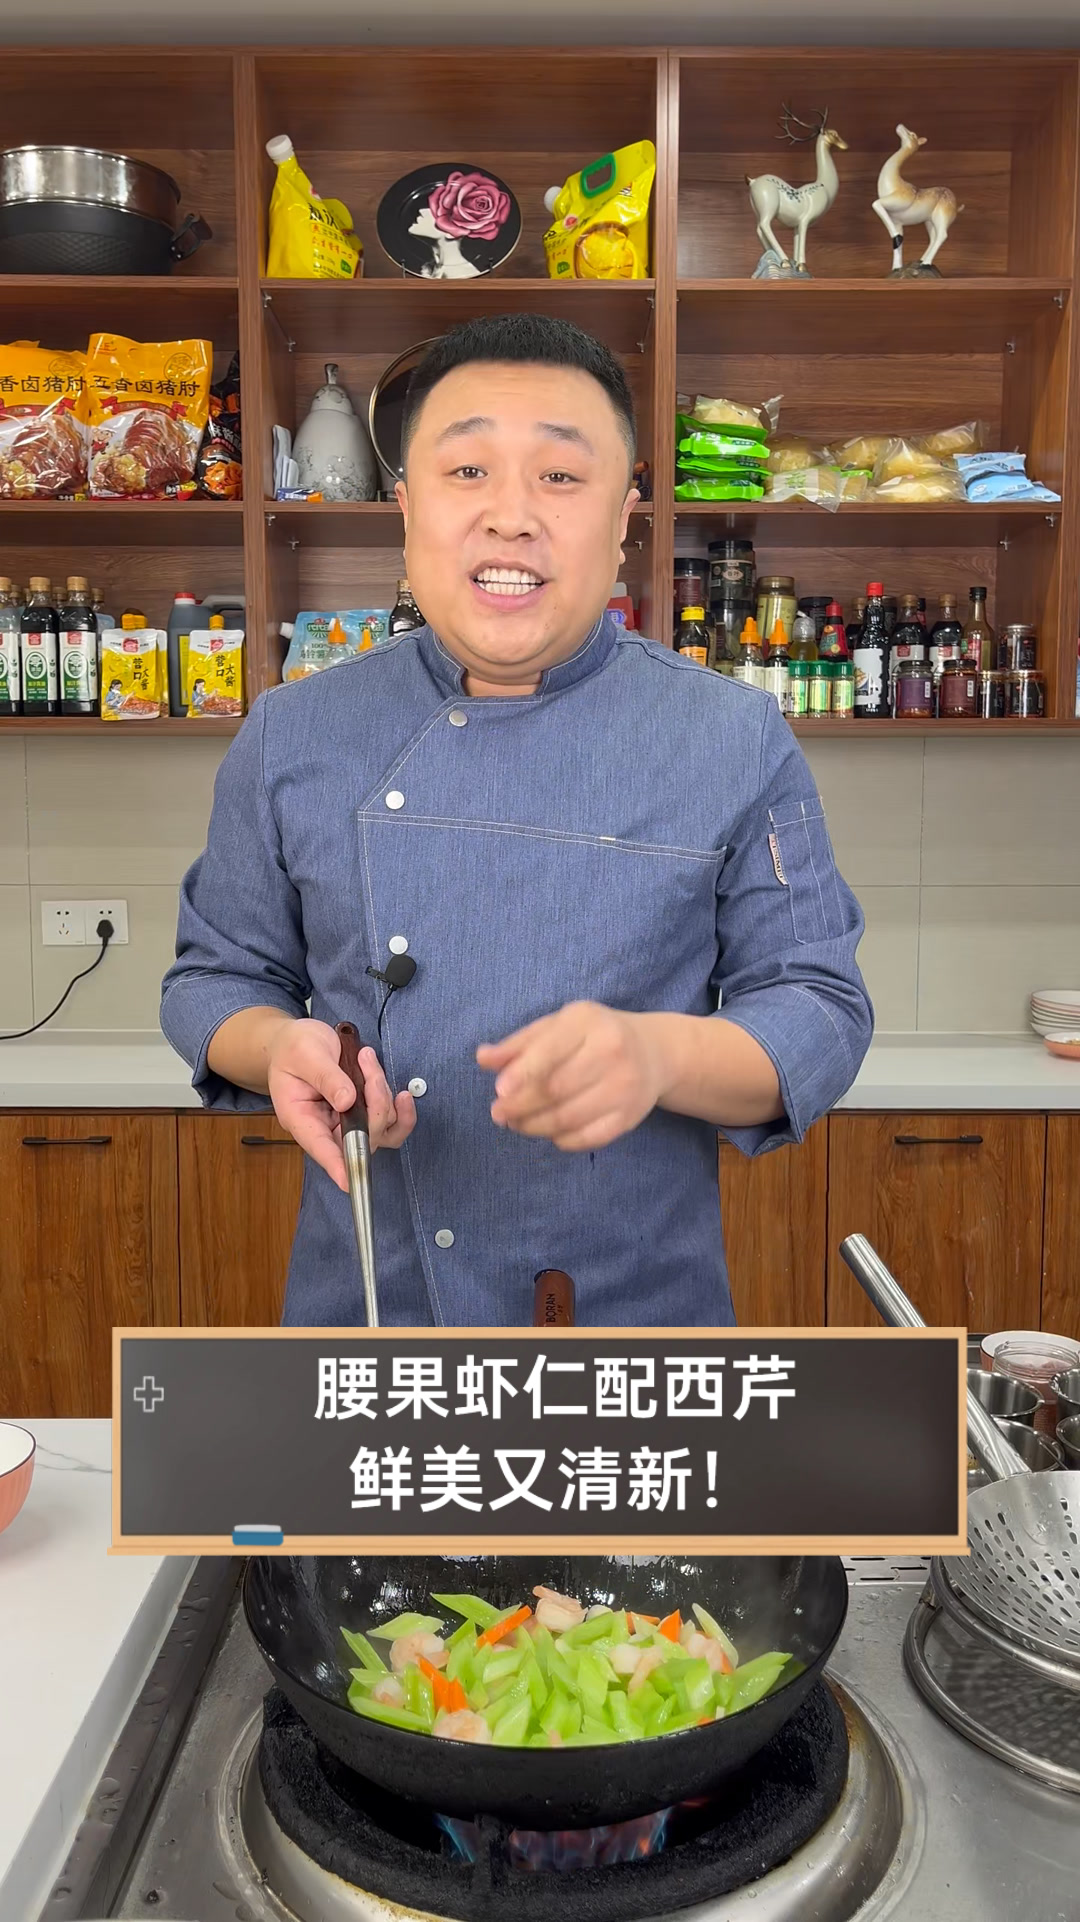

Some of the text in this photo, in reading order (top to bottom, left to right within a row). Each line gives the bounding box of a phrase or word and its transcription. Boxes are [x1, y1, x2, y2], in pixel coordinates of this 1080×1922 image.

[0, 375, 86, 393] 香卤猪肘
[90, 374, 200, 398] 五香卤猪肘
[545, 1292, 557, 1323] BORAN
